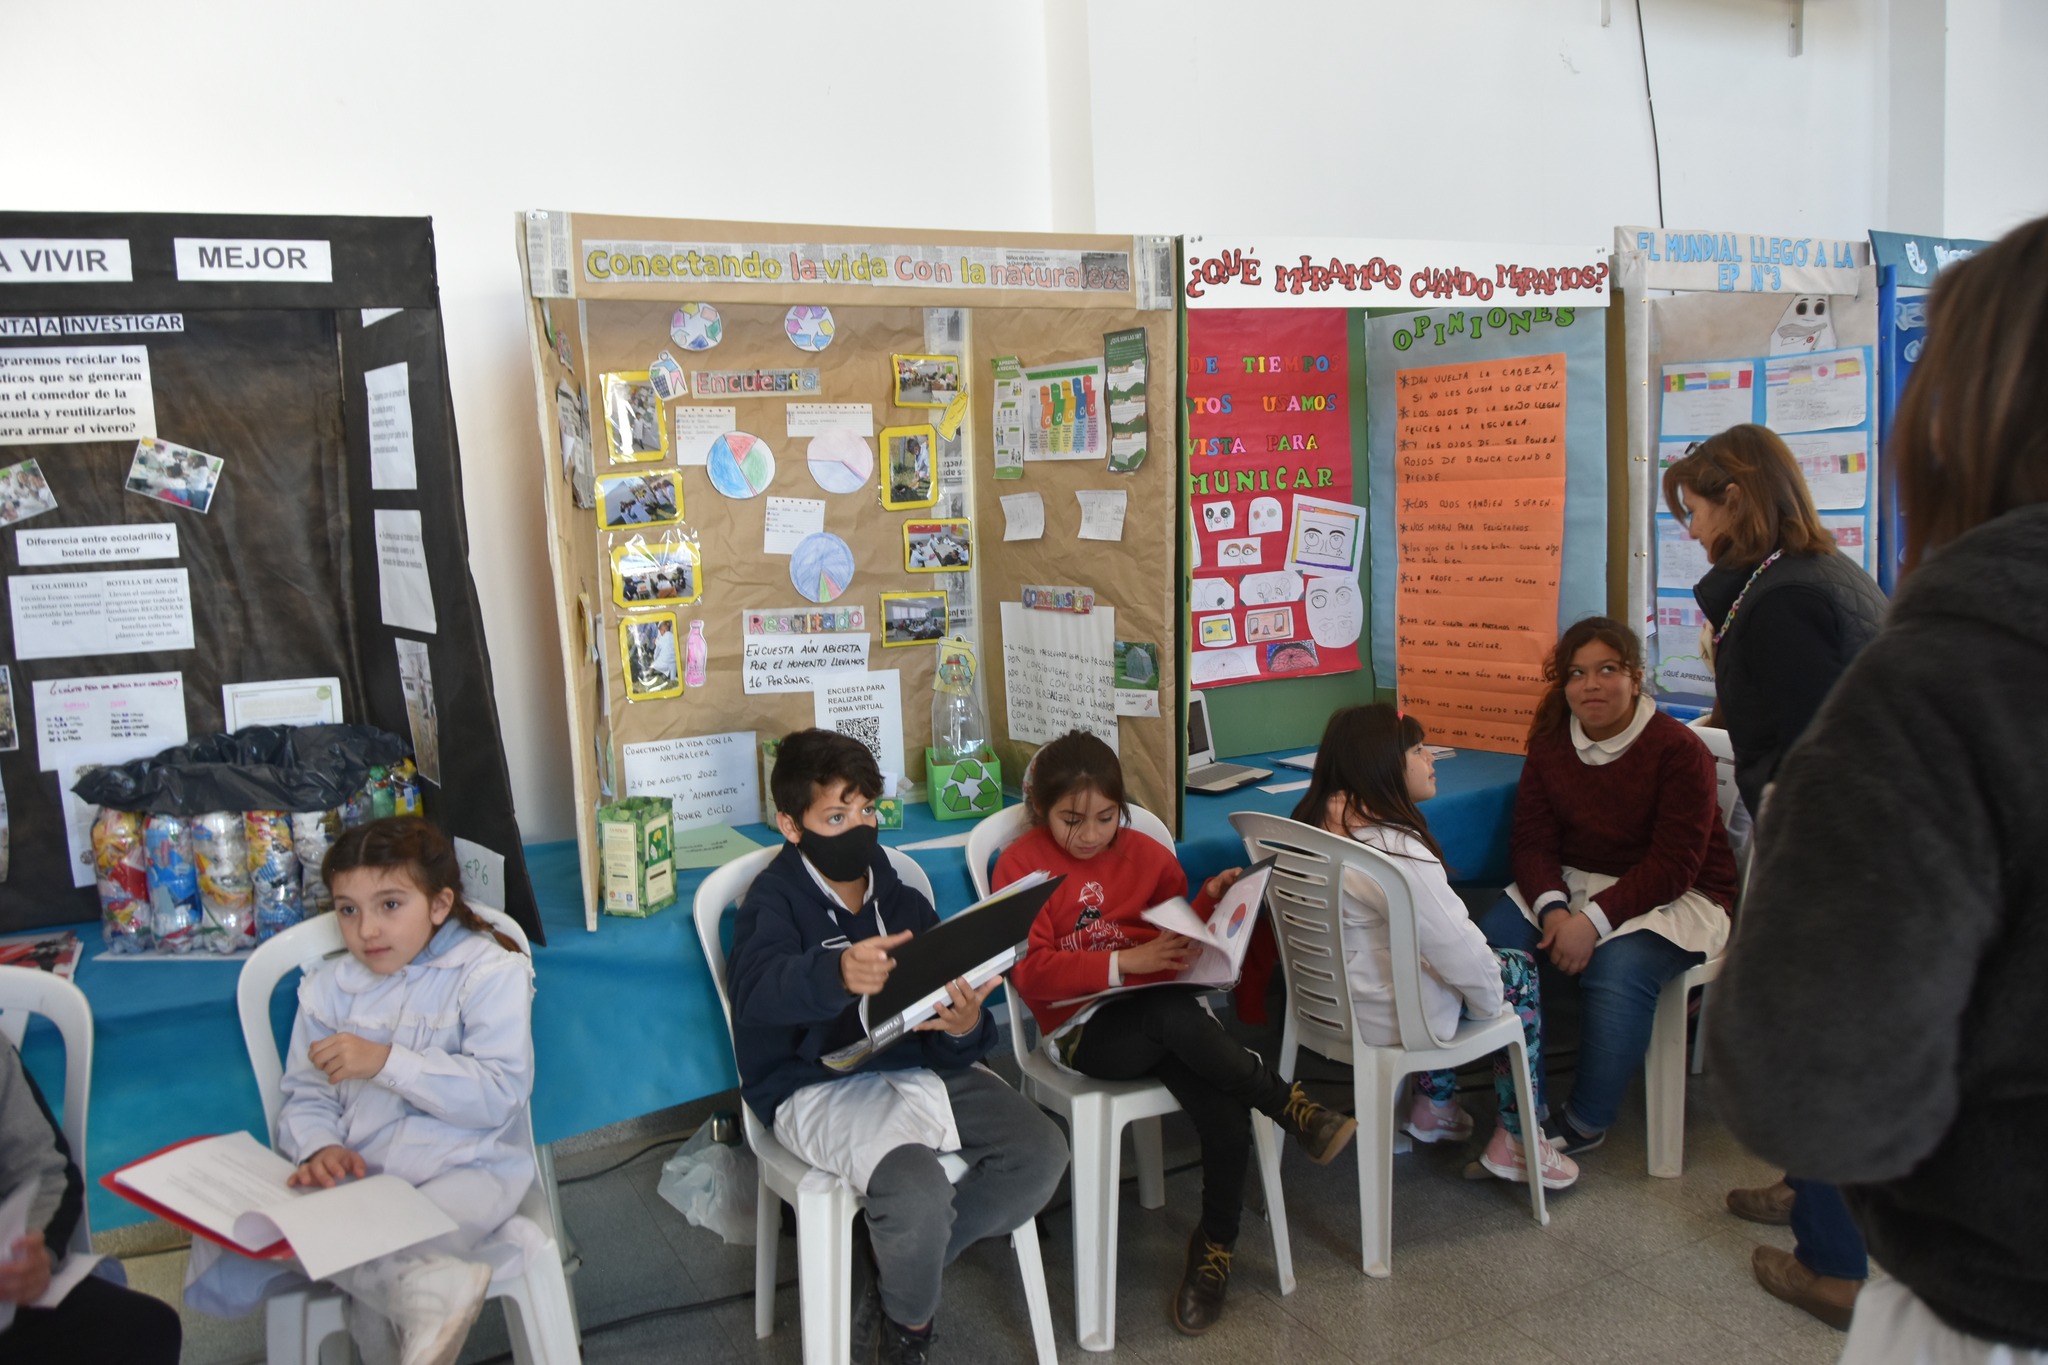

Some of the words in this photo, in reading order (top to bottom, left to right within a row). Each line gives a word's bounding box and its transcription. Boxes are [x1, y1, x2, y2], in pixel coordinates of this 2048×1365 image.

[1637, 232, 1660, 261] EL
[1665, 233, 1742, 262] MUNDIAL
[1750, 236, 1811, 267] LLEGÓ
[1814, 242, 1827, 267] A
[1834, 242, 1854, 268] LA
[20, 249, 109, 272] VIVIR
[199, 246, 308, 270] MEJOR
[587, 250, 782, 279] Conectando
[789, 251, 818, 281] la
[823, 252, 888, 281] vida
[894, 256, 952, 282] Con
[961, 256, 986, 283] la
[991, 262, 1129, 289] naturaleza
[1186, 247, 1262, 298] ¿QUÉ
[1274, 255, 1402, 295] MIRAMOS
[1410, 266, 1494, 301] CUANDO
[1496, 262, 1608, 296] MIRAMOS?
[1718, 263, 1740, 292] EP
[45, 319, 58, 333] A
[65, 314, 182, 332] INVESTIGAR
[1393, 307, 1575, 351] OPINIONES
[66, 354, 117, 364] reciclar
[122, 354, 141, 364] los
[1189, 356, 1218, 374] DE
[1242, 354, 1340, 373] TIEMPOS
[40, 374, 64, 384] que
[88, 372, 142, 383] generan
[697, 370, 816, 394] Encuesta
[15, 391, 27, 400] el
[32, 390, 90, 400] comedor
[95, 389, 110, 399] de
[114, 388, 126, 398] la
[1263, 394, 1336, 412] USAMOS
[44, 409, 51, 420] y
[56, 406, 136, 417] reutilizarlos
[28, 425, 69, 435] armar
[74, 424, 85, 434] el
[90, 422, 136, 434] vivero?
[1266, 434, 1319, 452] PARA
[1190, 466, 1334, 495] MUNICAR
[26, 534, 79, 546] Diferencia
[82, 534, 108, 544] entre
[111, 532, 163, 543] ecoladrillo
[165, 532, 171, 541] y
[62, 548, 96, 558] botella
[99, 547, 112, 556] de
[115, 546, 141, 555] amor
[32, 582, 88, 590] ECOLADRILLO
[1023, 588, 1094, 613] Conclusión
[749, 609, 862, 634] Resultado
[746, 644, 794, 656] ENCUESTA
[801, 640, 818, 654] AÚN
[750, 660, 766, 670] POR
[787, 658, 827, 668] MOMENTO
[749, 676, 762, 688] 16
[828, 686, 864, 695] ENCUESTA
[828, 696, 862, 705] REALIZAR
[828, 706, 853, 714] FORMA
